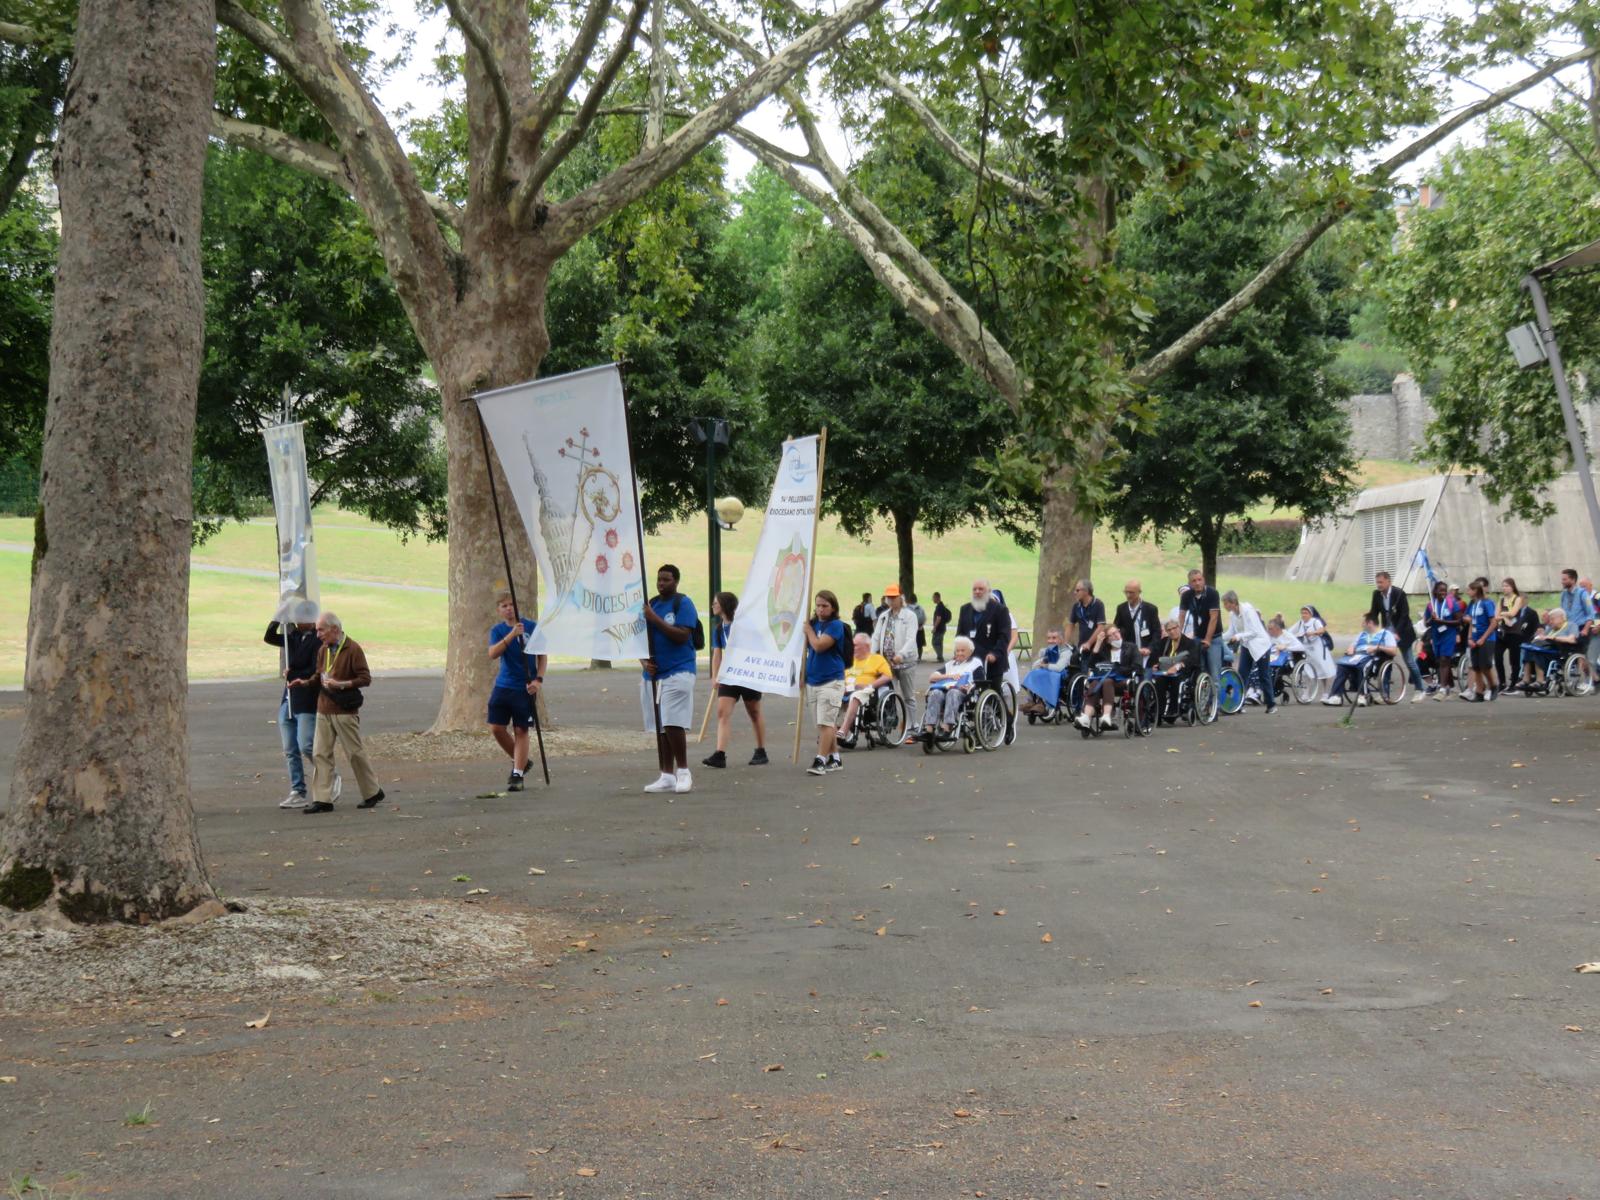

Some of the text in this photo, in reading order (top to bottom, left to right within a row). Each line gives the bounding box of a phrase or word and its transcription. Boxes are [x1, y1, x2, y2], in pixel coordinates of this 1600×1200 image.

[583, 589, 642, 614] DIOCESI DI
[744, 656, 785, 669] AVE MARIA
[726, 666, 788, 683] PIENA DI GRAZIA
